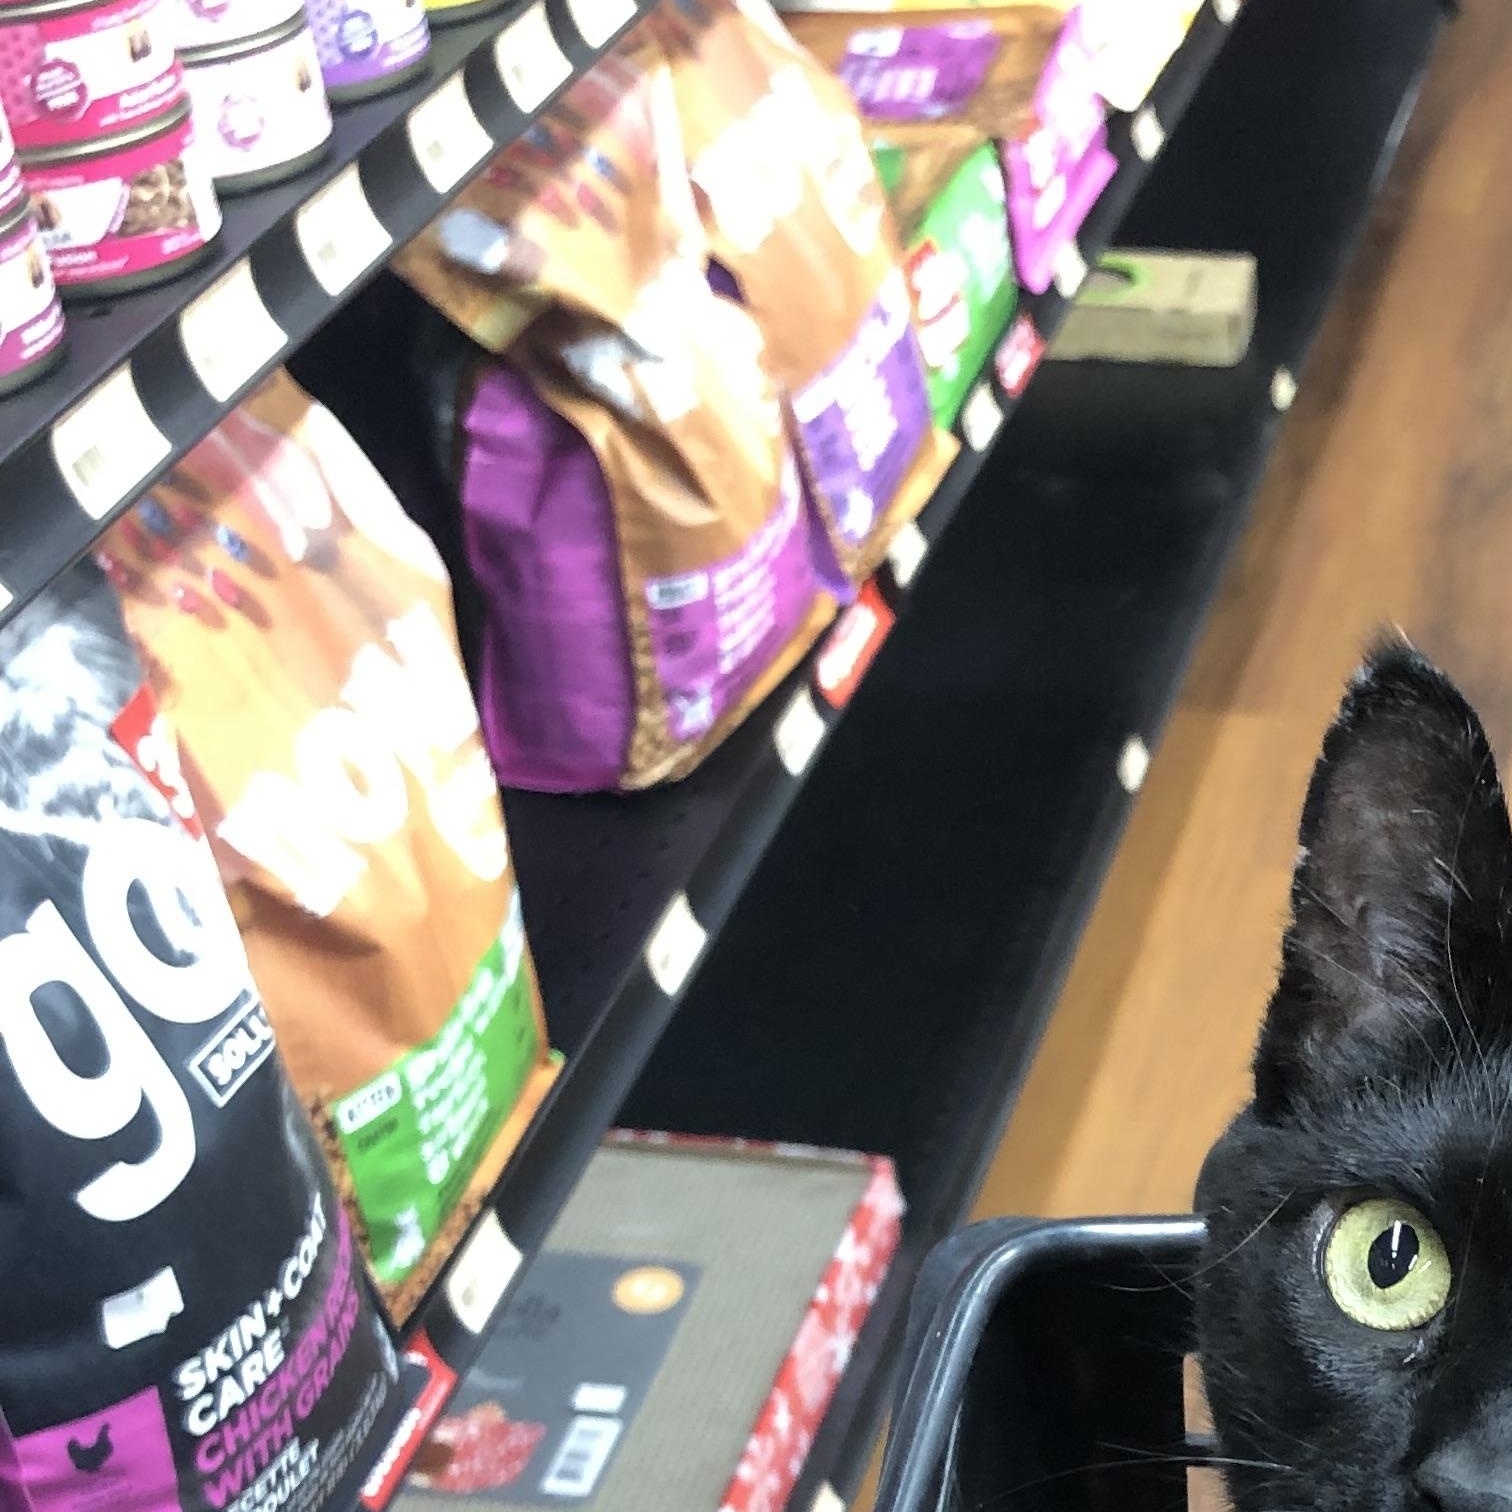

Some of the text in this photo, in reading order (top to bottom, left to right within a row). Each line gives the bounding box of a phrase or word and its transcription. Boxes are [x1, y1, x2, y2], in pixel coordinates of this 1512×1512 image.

[0, 816, 254, 1222] go
[186, 1328, 285, 1436] CARE
[196, 1310, 328, 1474] CHICKEN
[204, 1406, 293, 1508] WITH
